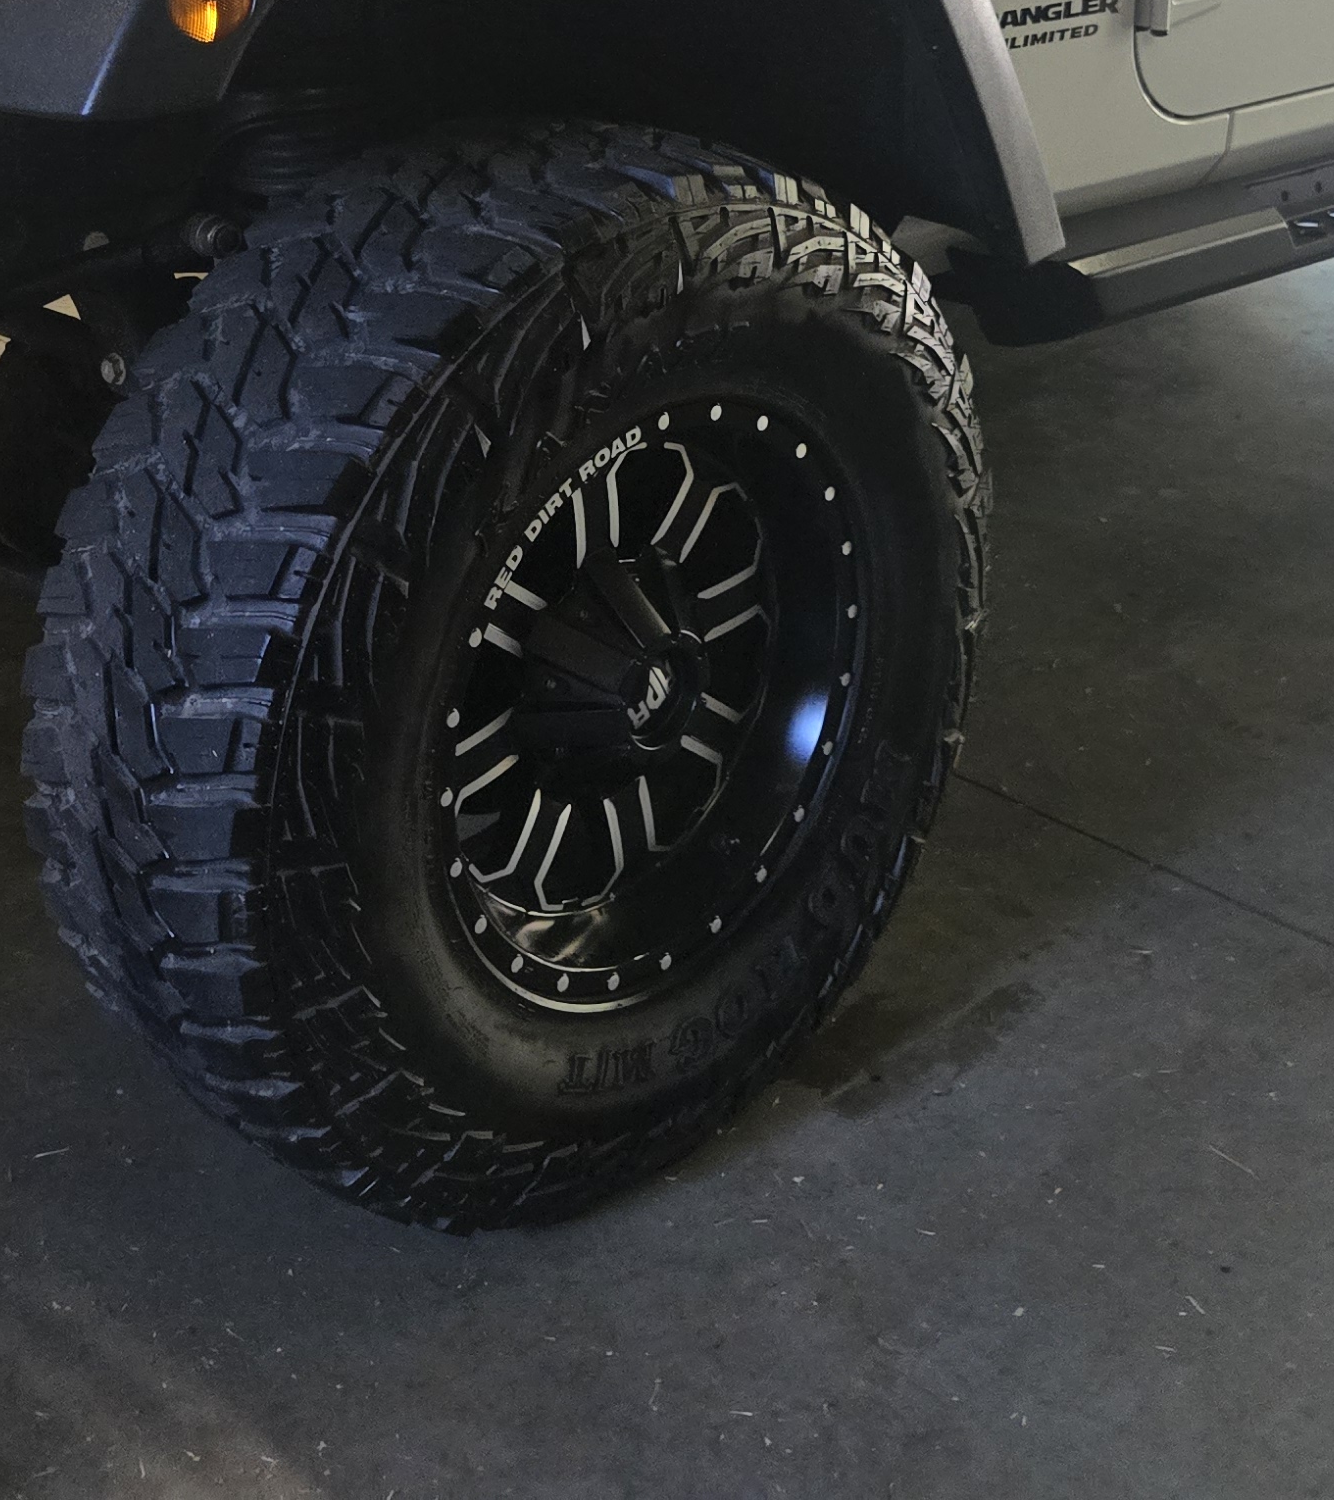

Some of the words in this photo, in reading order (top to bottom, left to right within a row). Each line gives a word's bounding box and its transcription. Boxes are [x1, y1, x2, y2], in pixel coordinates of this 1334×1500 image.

[1005, 23, 1098, 50] LIMITED
[484, 545, 524, 610] RED
[524, 478, 573, 542] DIRT
[578, 425, 643, 482] ROAD
